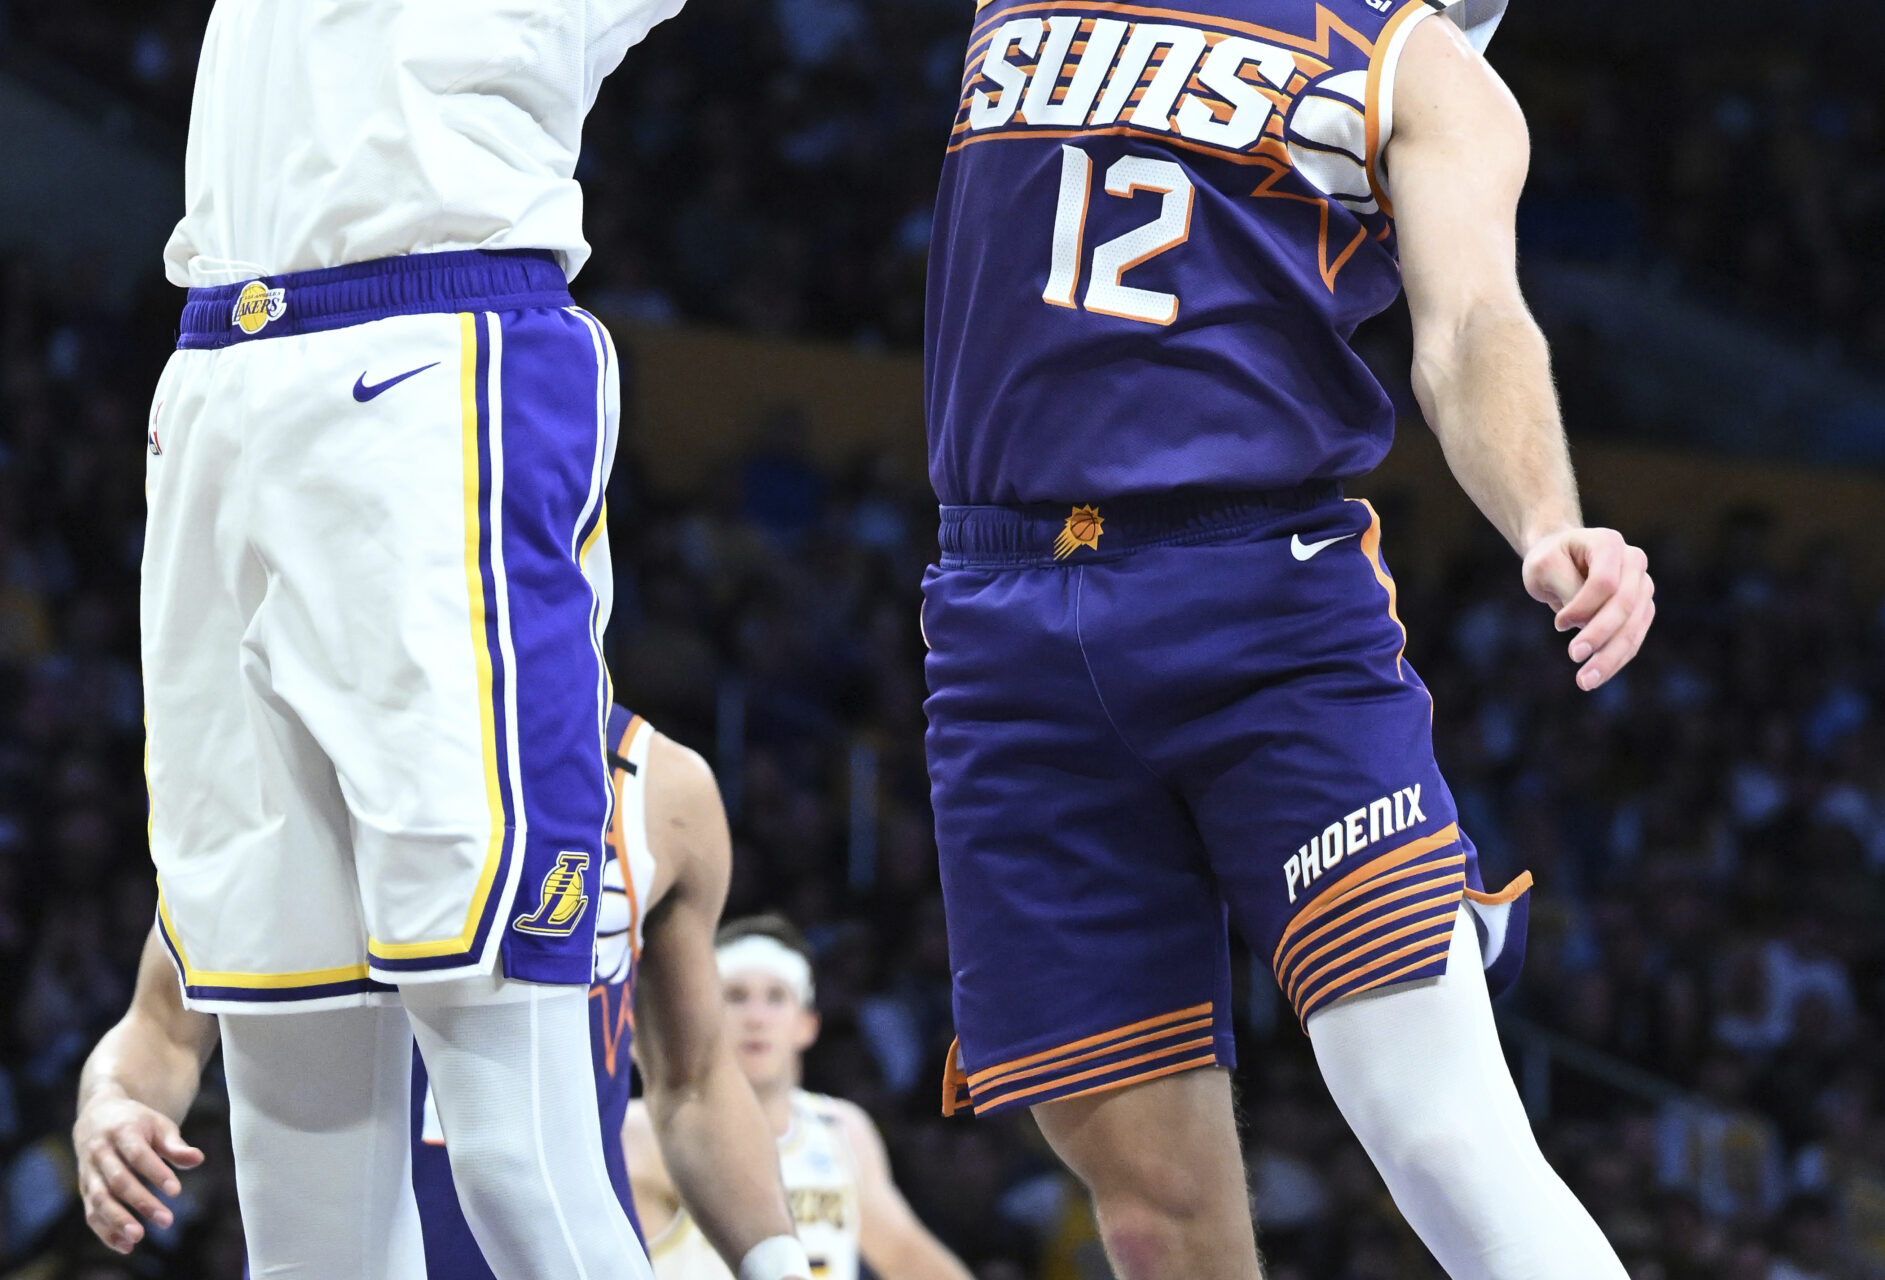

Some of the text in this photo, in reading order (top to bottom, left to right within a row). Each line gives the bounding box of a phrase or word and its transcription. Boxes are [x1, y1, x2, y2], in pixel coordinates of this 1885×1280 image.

[969, 16, 1296, 150] SUNS
[1042, 144, 1195, 326] 12
[232, 297, 282, 321] LAKERS
[1283, 783, 1427, 905] PHOENIX
